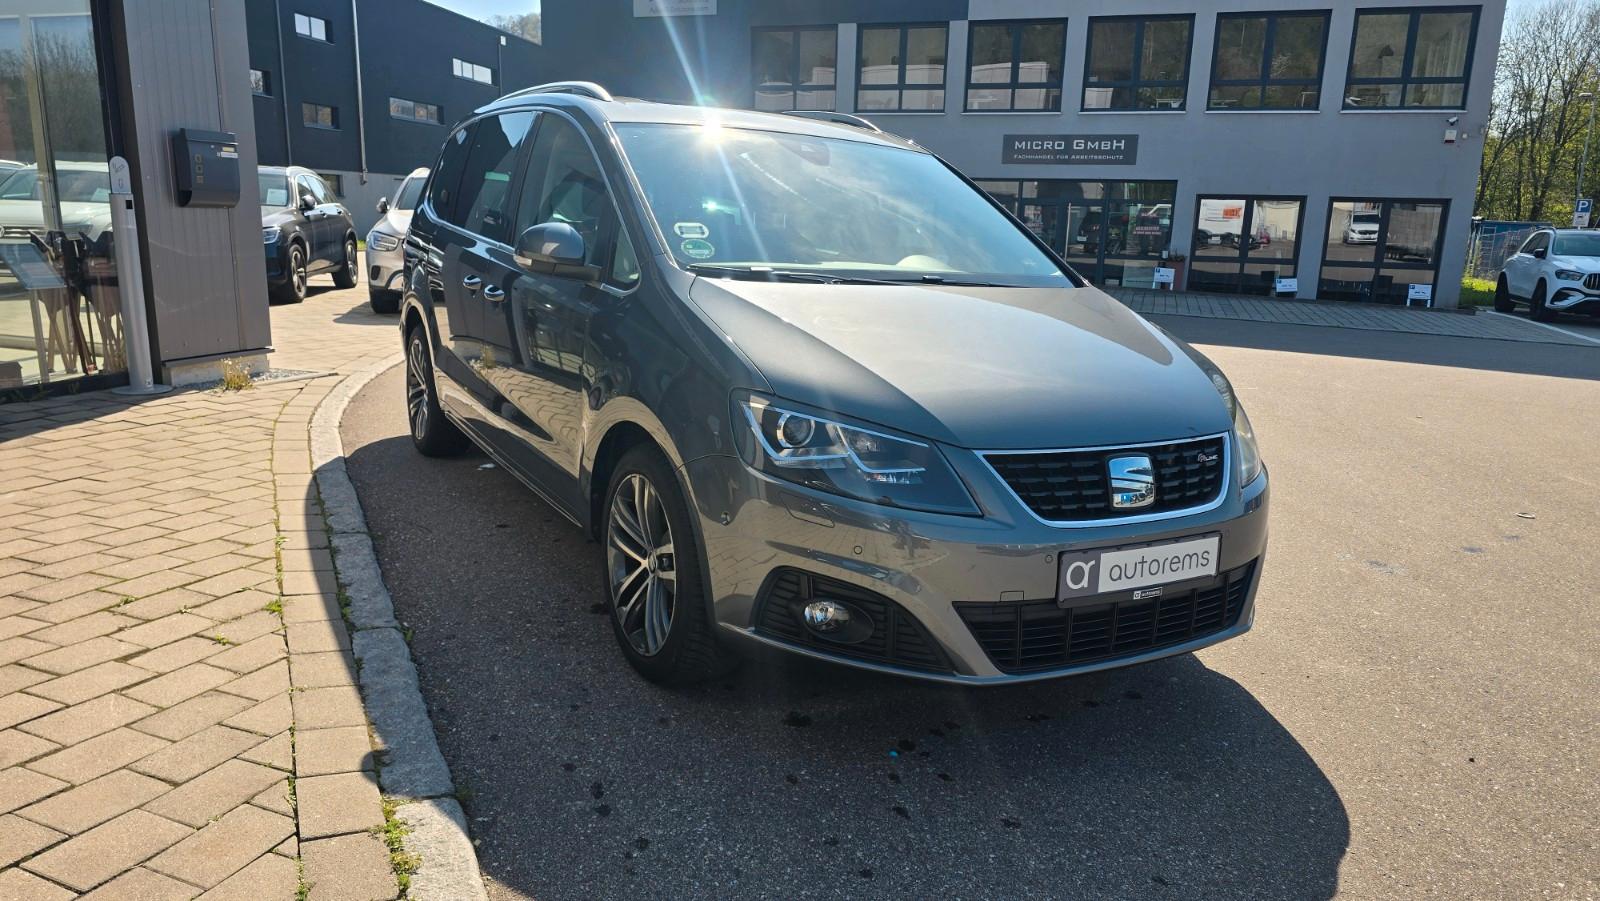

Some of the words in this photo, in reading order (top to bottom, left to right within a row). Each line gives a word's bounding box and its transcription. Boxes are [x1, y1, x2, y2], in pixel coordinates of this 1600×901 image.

[1014, 140, 1065, 150] MICRO
[1577, 200, 1589, 211] P
[1109, 550, 1210, 582] autorems
